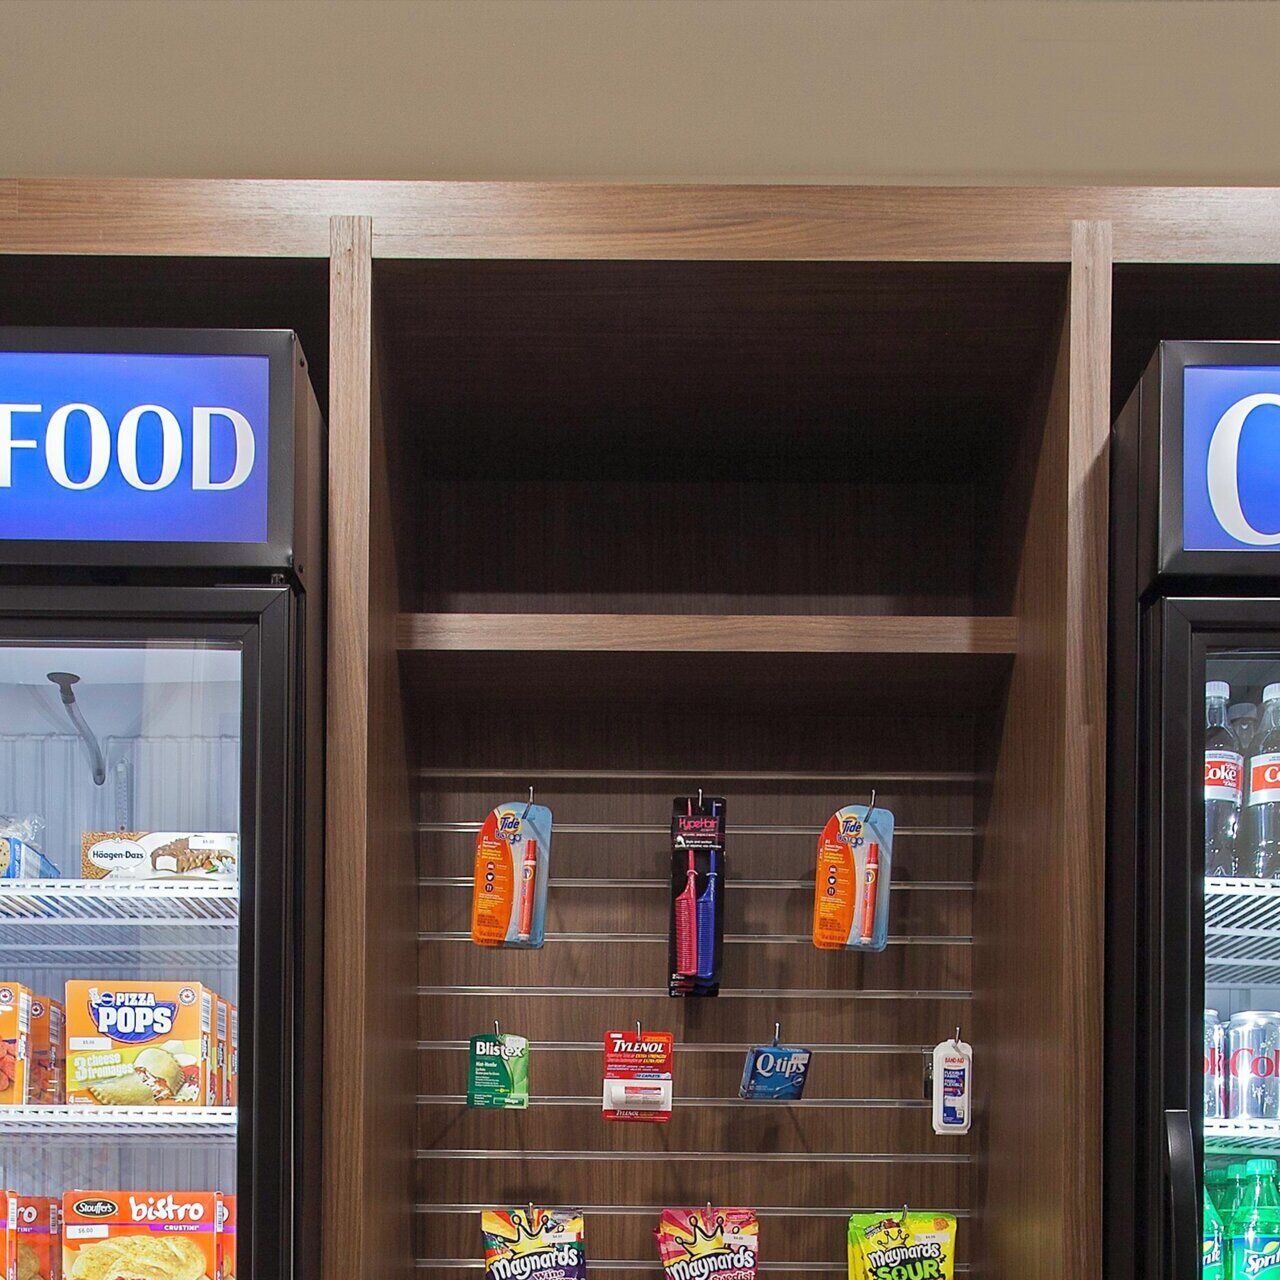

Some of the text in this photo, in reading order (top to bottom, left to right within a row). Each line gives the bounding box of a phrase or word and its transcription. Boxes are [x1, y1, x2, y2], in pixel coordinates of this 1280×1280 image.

[500, 816, 520, 831] Tide
[842, 819, 861, 835] Tide
[116, 992, 156, 1007] PIZZA
[97, 1006, 171, 1034] POPS
[475, 1041, 524, 1061] Blistex
[613, 1039, 664, 1053] TYLENOL
[73, 1055, 88, 1082] 3
[129, 1194, 205, 1222] bistro
[867, 1242, 941, 1269] Maynards
[532, 1269, 566, 1280] Wine
